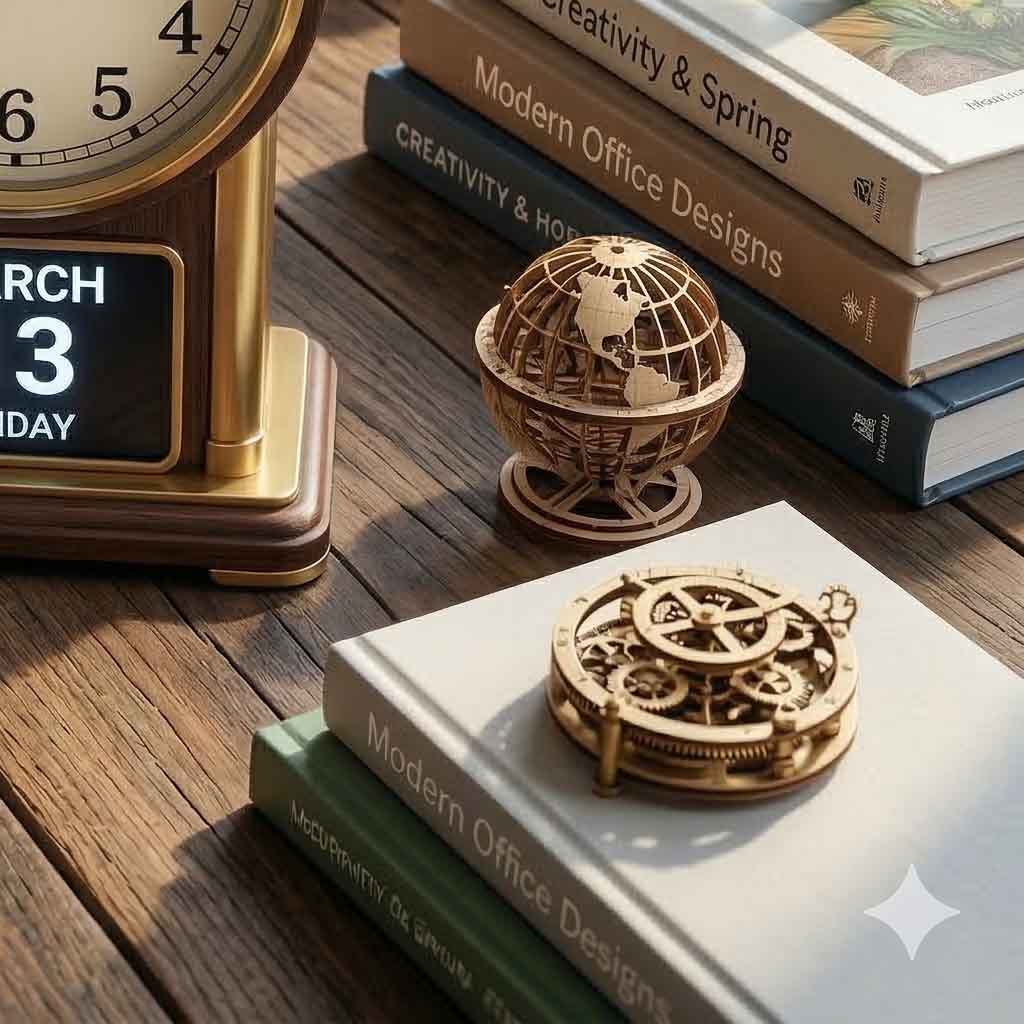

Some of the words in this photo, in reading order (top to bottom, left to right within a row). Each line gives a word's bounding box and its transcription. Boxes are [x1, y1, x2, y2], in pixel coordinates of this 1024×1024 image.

[158, 0, 203, 54] 4
[92, 67, 132, 121] 5
[671, 55, 691, 96] &
[699, 72, 793, 164] Spring
[395, 121, 510, 210] CREATIVITY
[513, 195, 529, 225] &
[474, 55, 575, 149] Modern
[582, 125, 664, 202] Office
[671, 176, 783, 279] Designs
[366, 711, 466, 834] Modern
[472, 817, 553, 914] Office
